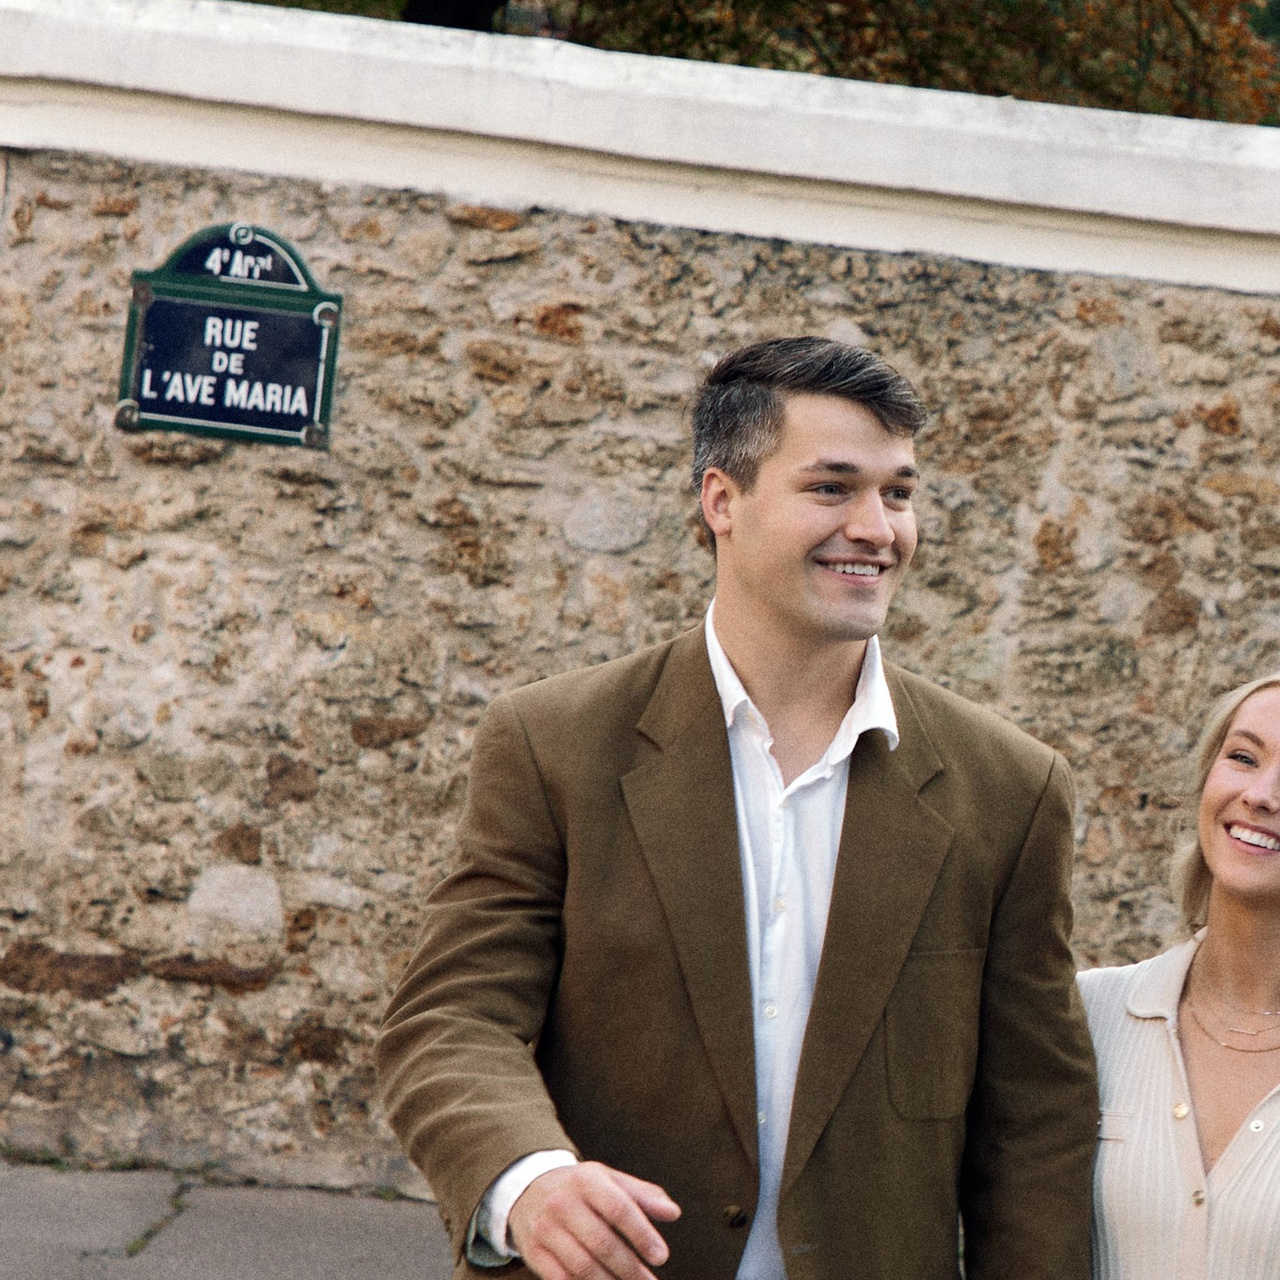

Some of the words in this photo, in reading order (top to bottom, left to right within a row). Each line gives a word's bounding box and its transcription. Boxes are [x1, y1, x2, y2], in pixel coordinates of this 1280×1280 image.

[204, 316, 260, 351] RUE
[211, 350, 245, 376] DE
[141, 368, 217, 406] L'AVE
[224, 377, 309, 417] MARIA
